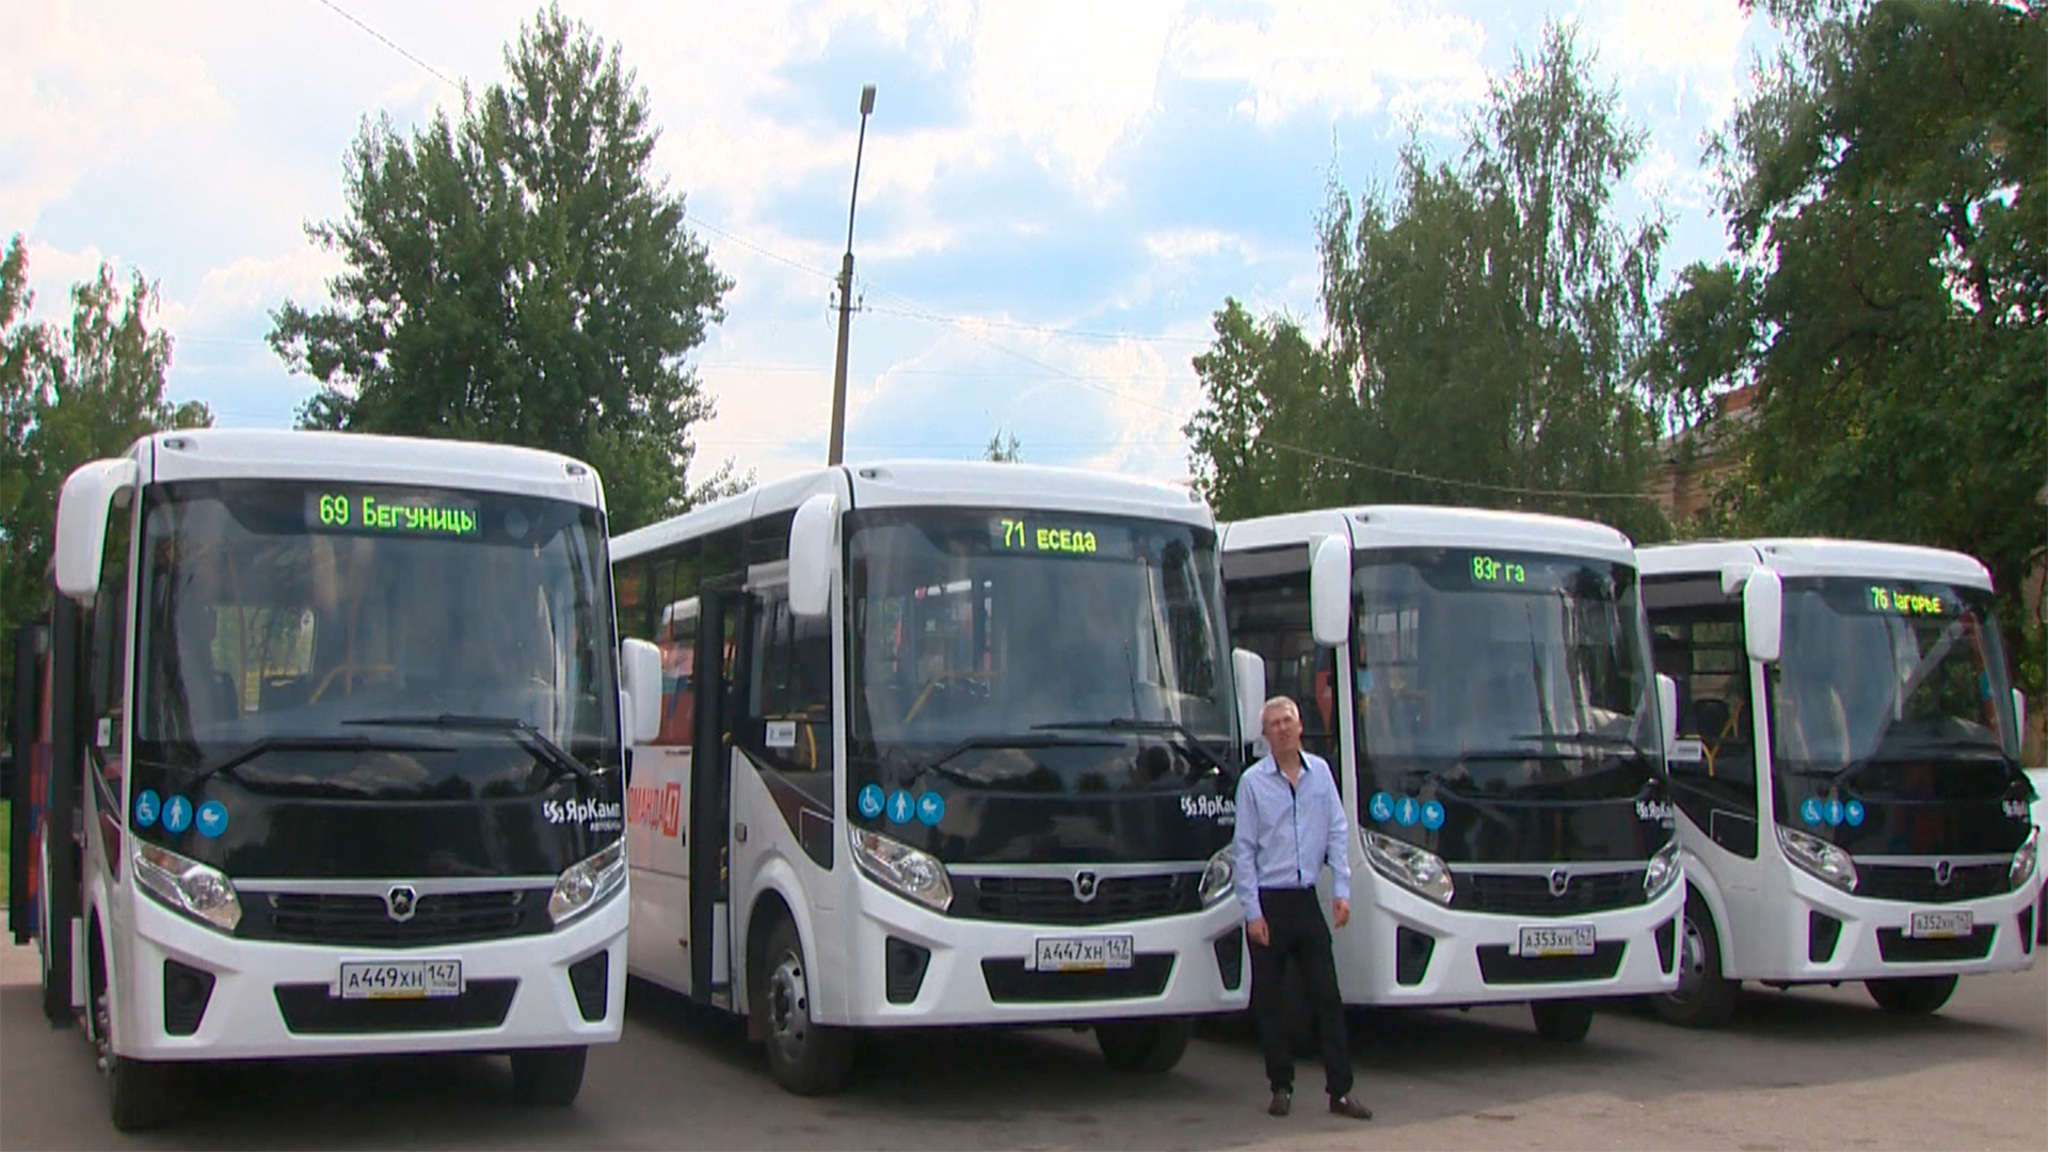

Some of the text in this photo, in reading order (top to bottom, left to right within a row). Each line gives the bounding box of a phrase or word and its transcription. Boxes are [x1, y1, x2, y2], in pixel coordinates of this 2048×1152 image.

[320, 493, 349, 525] 69
[1001, 519, 1025, 548] 71
[1870, 586, 1888, 611] 76
[1043, 940, 1128, 960] А447ХН 147
[349, 965, 455, 988] А449ХН 147
